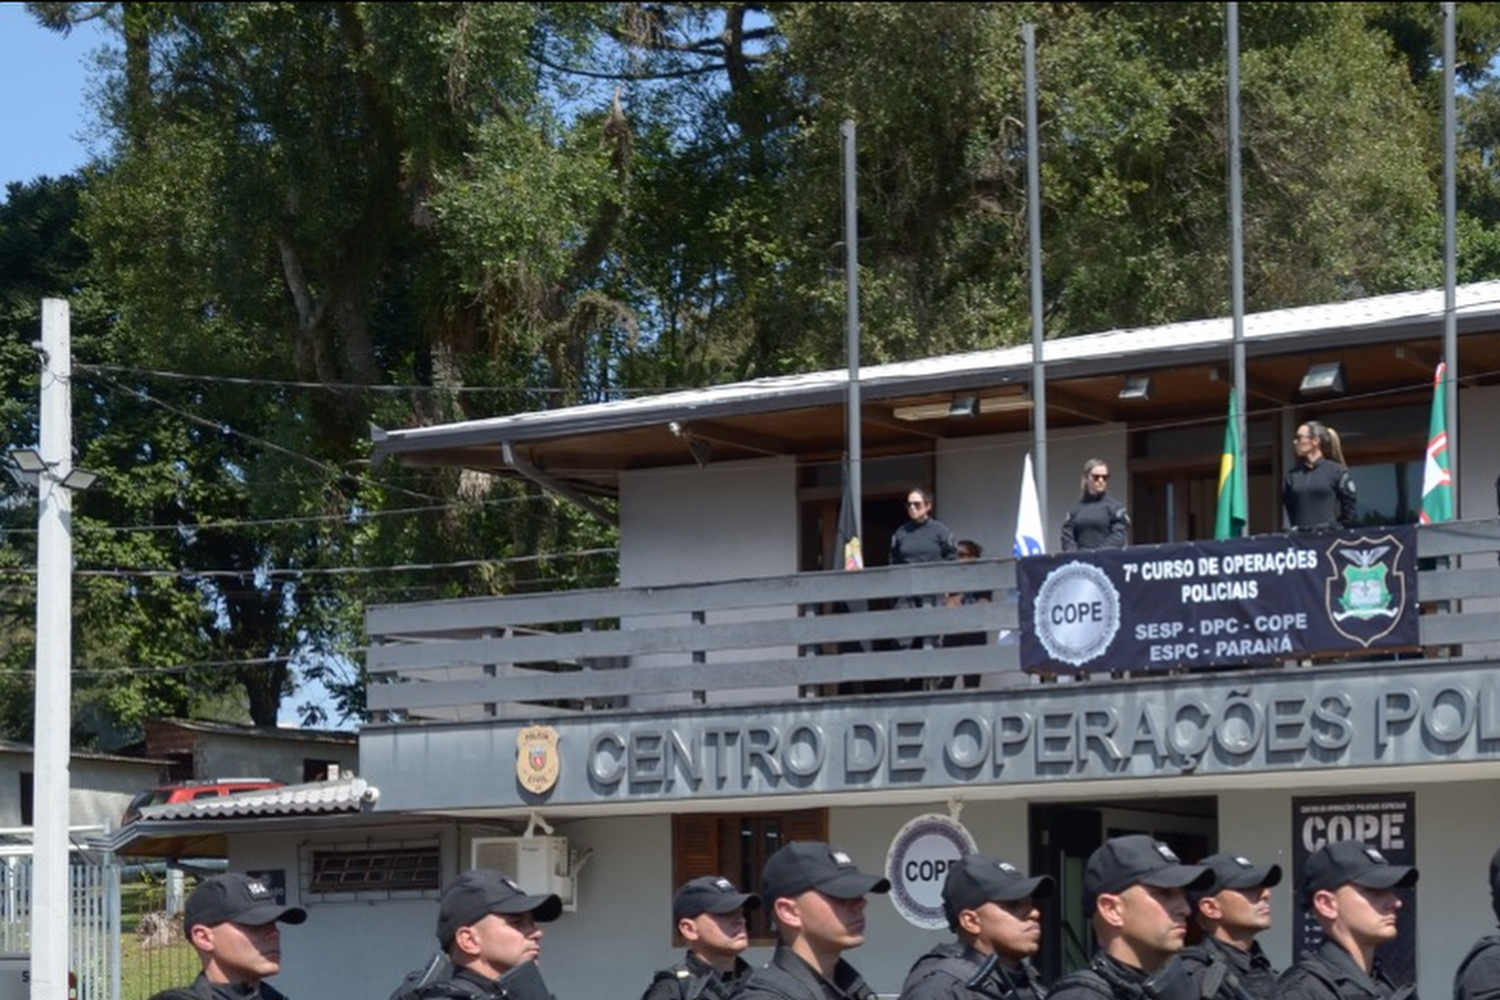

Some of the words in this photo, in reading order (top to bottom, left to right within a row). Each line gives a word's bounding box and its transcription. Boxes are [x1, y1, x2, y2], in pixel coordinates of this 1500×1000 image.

[1141, 558, 1195, 581] CURSO
[1198, 557, 1220, 576] DE
[1222, 547, 1318, 575] OPERAÇÕES
[1181, 580, 1259, 603] POLICIAIS
[1051, 601, 1102, 625] COPE
[1135, 621, 1183, 640] SESP
[1200, 618, 1239, 636] DPC
[1254, 613, 1308, 632] COPE
[1149, 642, 1199, 662] ESPC
[1216, 633, 1293, 657] PARANÁ
[586, 716, 827, 787] CENTRO
[844, 720, 928, 776] DE
[944, 688, 1352, 772] OPERAÇÕES
[1302, 813, 1405, 852] COPE
